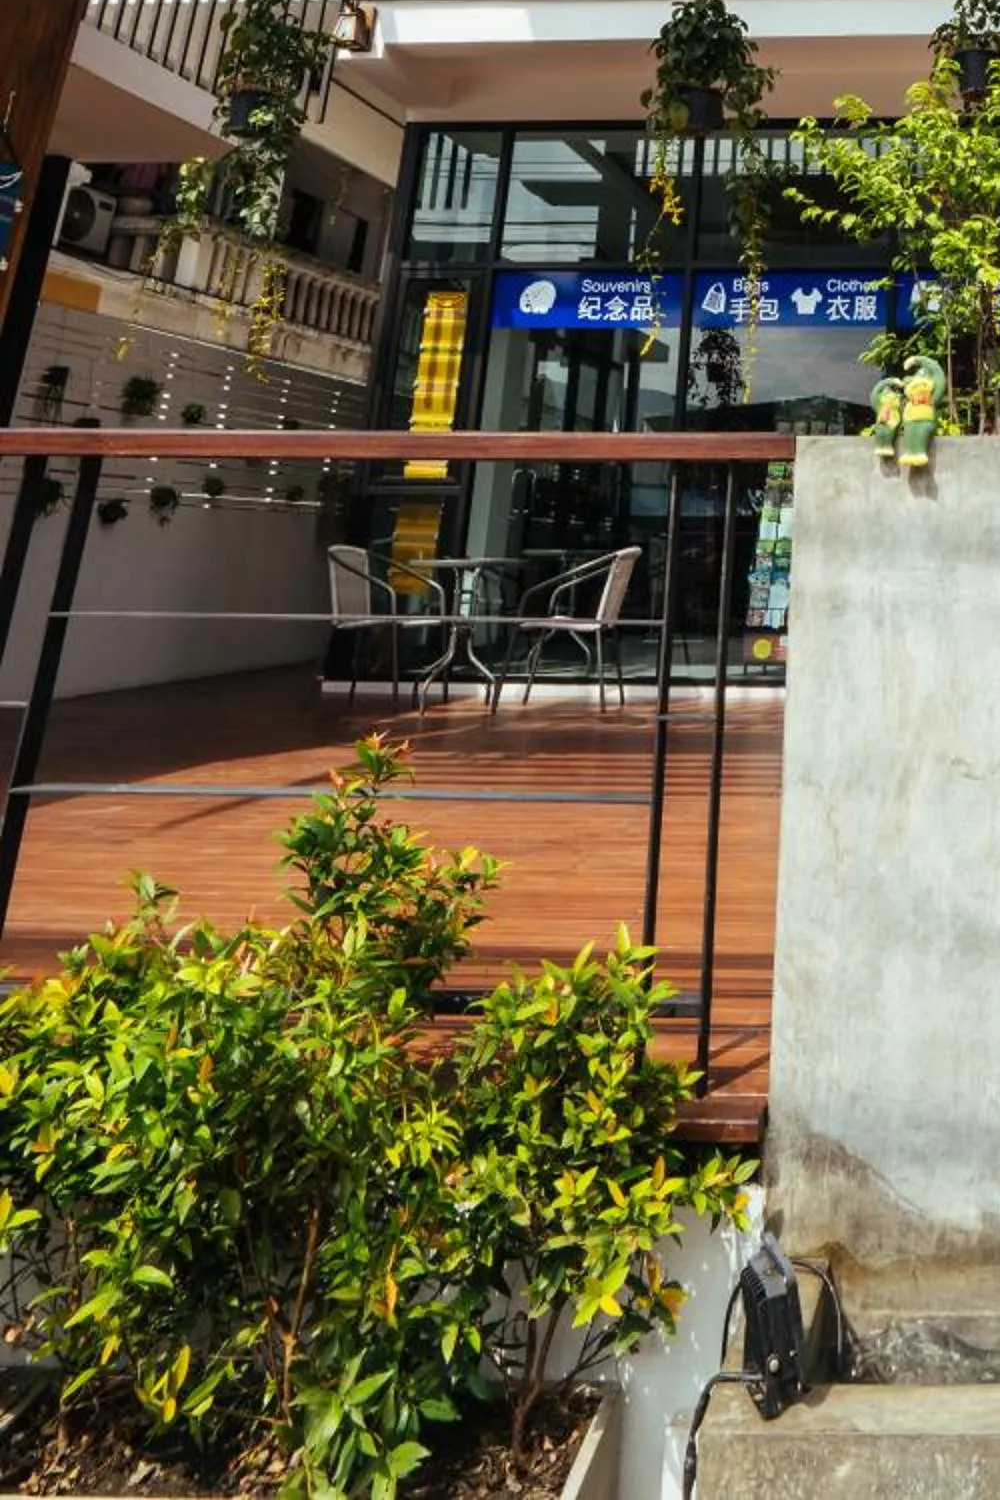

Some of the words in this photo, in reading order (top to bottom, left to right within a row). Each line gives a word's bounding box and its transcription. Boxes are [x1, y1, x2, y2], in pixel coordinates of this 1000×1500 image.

[581, 279, 652, 293] Souvenirs
[577, 295, 654, 321] 纪念品
[728, 296, 780, 322] 手包
[825, 295, 878, 321] 衣服
